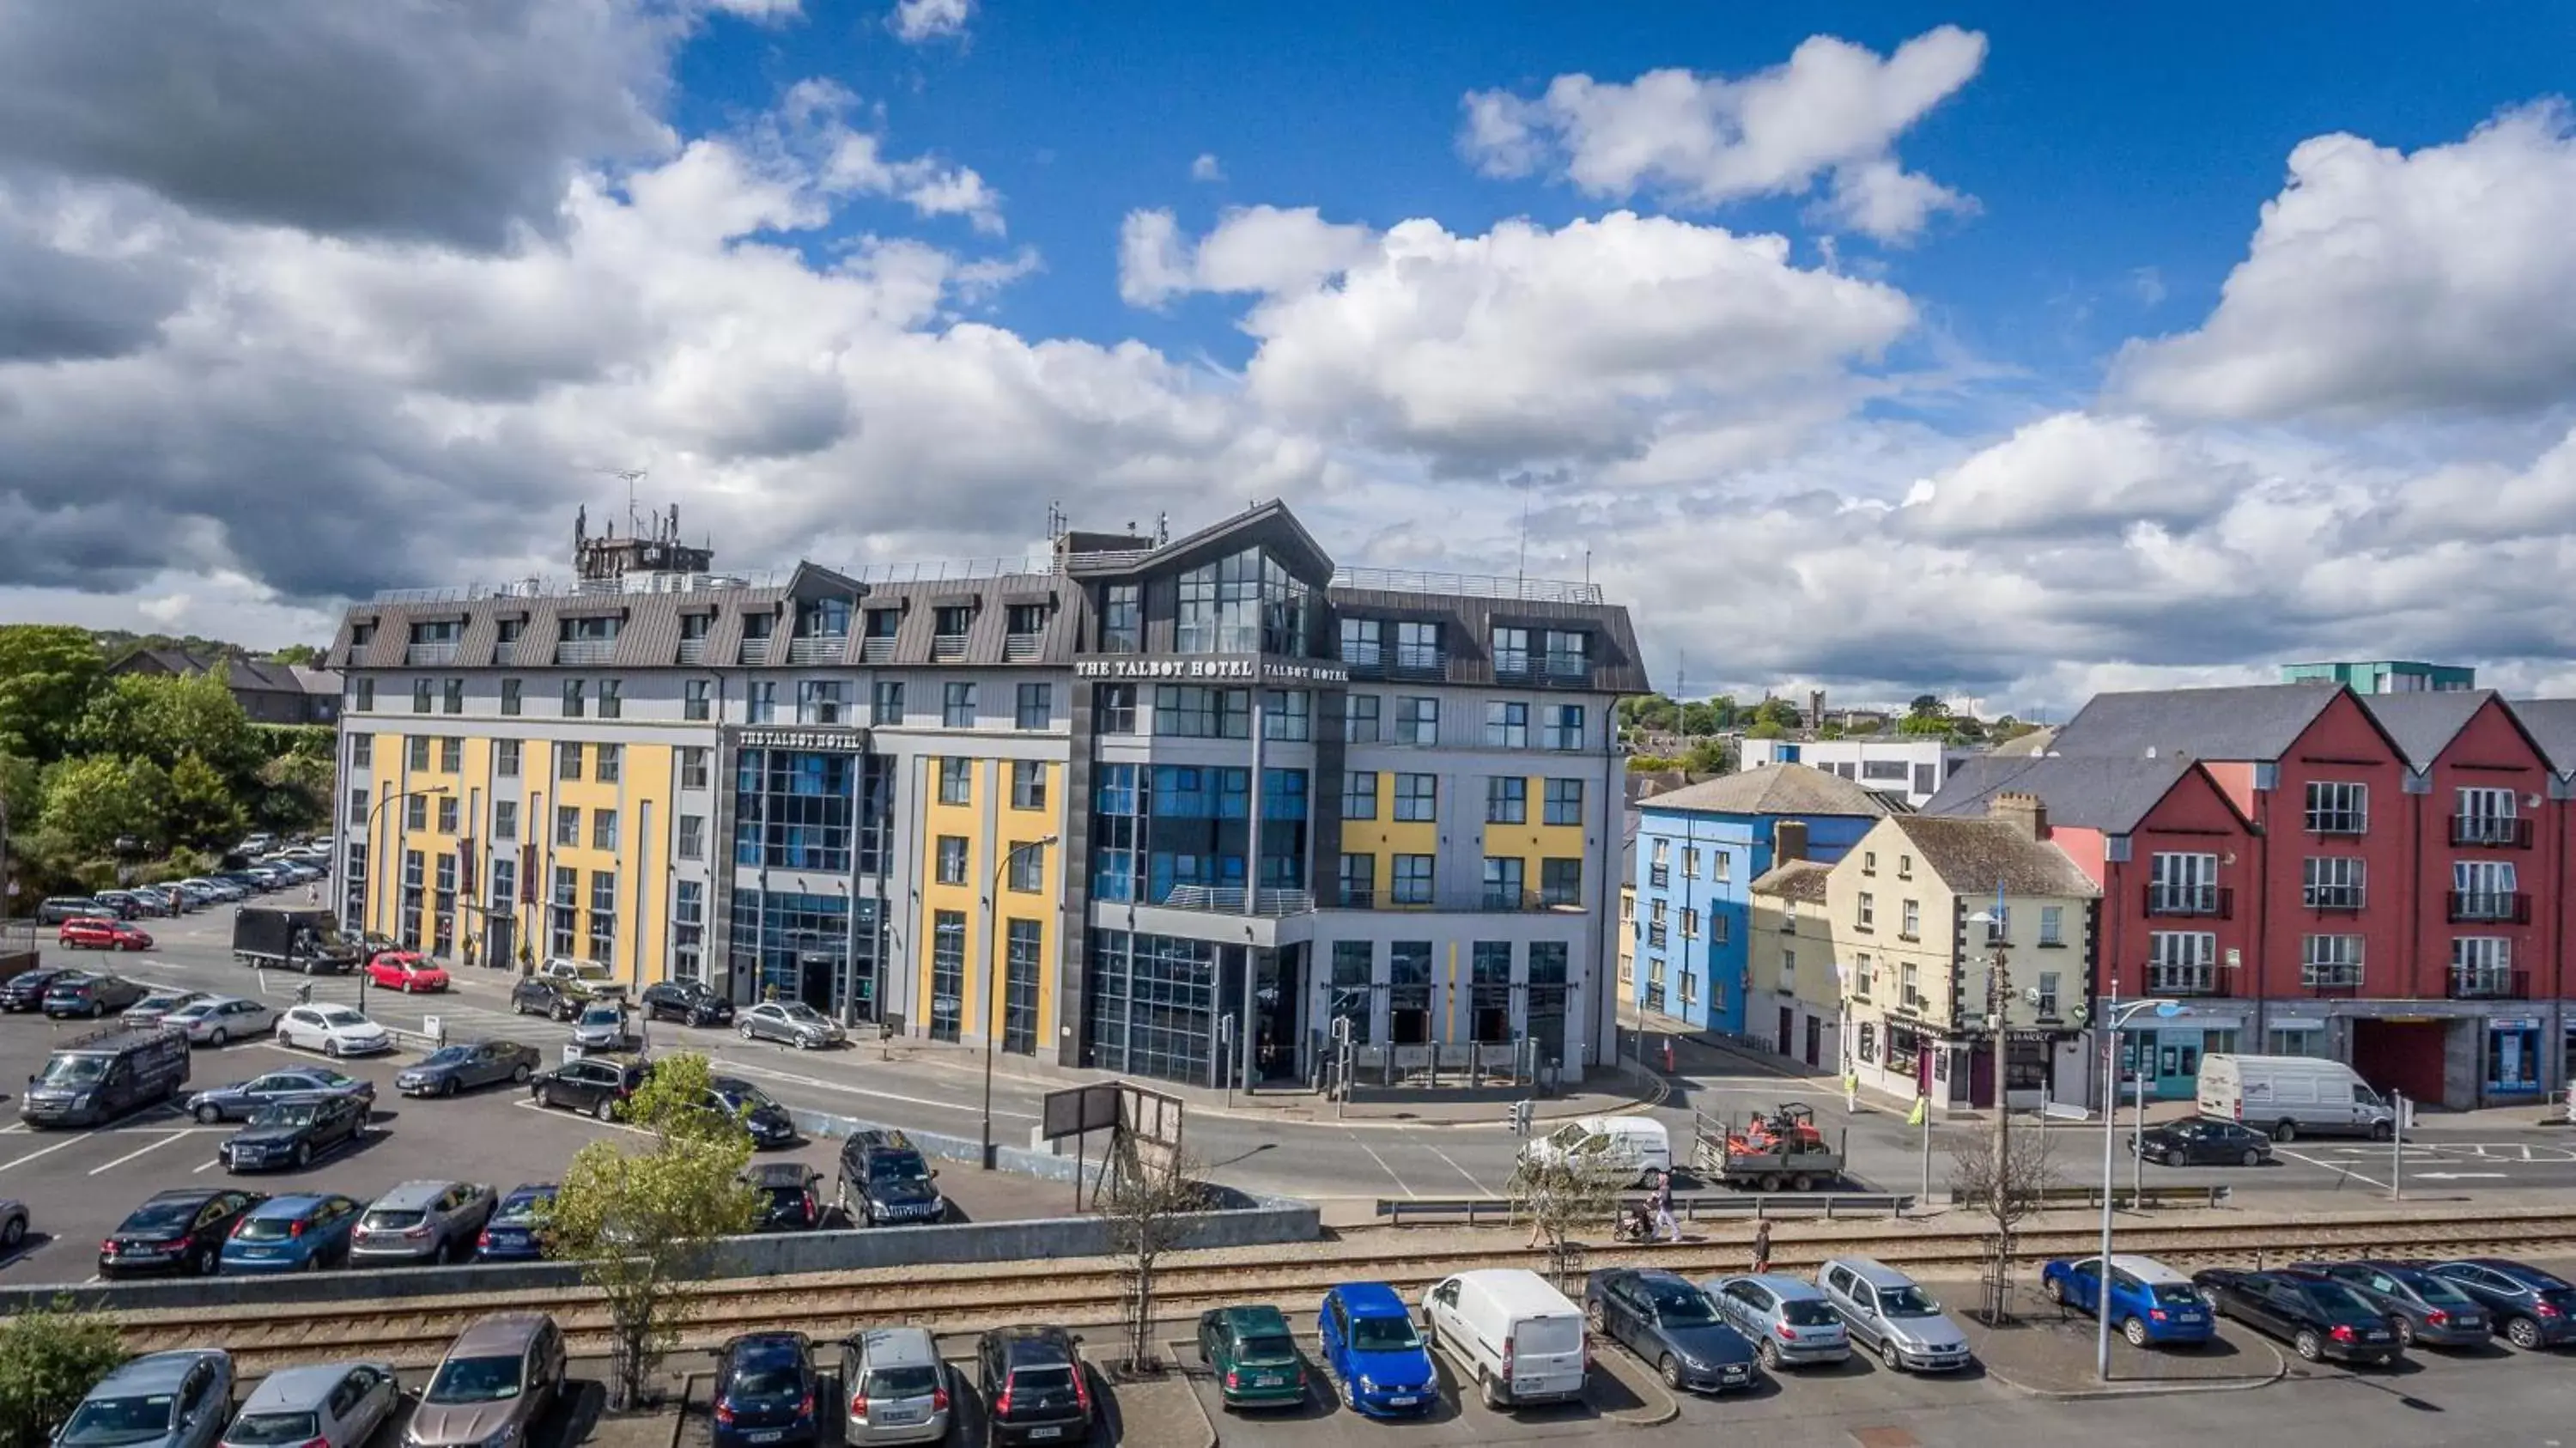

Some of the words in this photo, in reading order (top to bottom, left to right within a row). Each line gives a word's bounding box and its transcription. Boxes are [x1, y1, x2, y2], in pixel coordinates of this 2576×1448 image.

[1076, 660, 1110, 676] THE
[1116, 660, 1184, 677] TALBOT
[1190, 660, 1254, 677] HOTEL
[1263, 664, 1309, 678] TALBOT
[1312, 667, 1349, 681] HOTEL
[739, 732, 764, 745] THE
[765, 732, 815, 746] TALBOT
[817, 733, 860, 748] HOTEL
